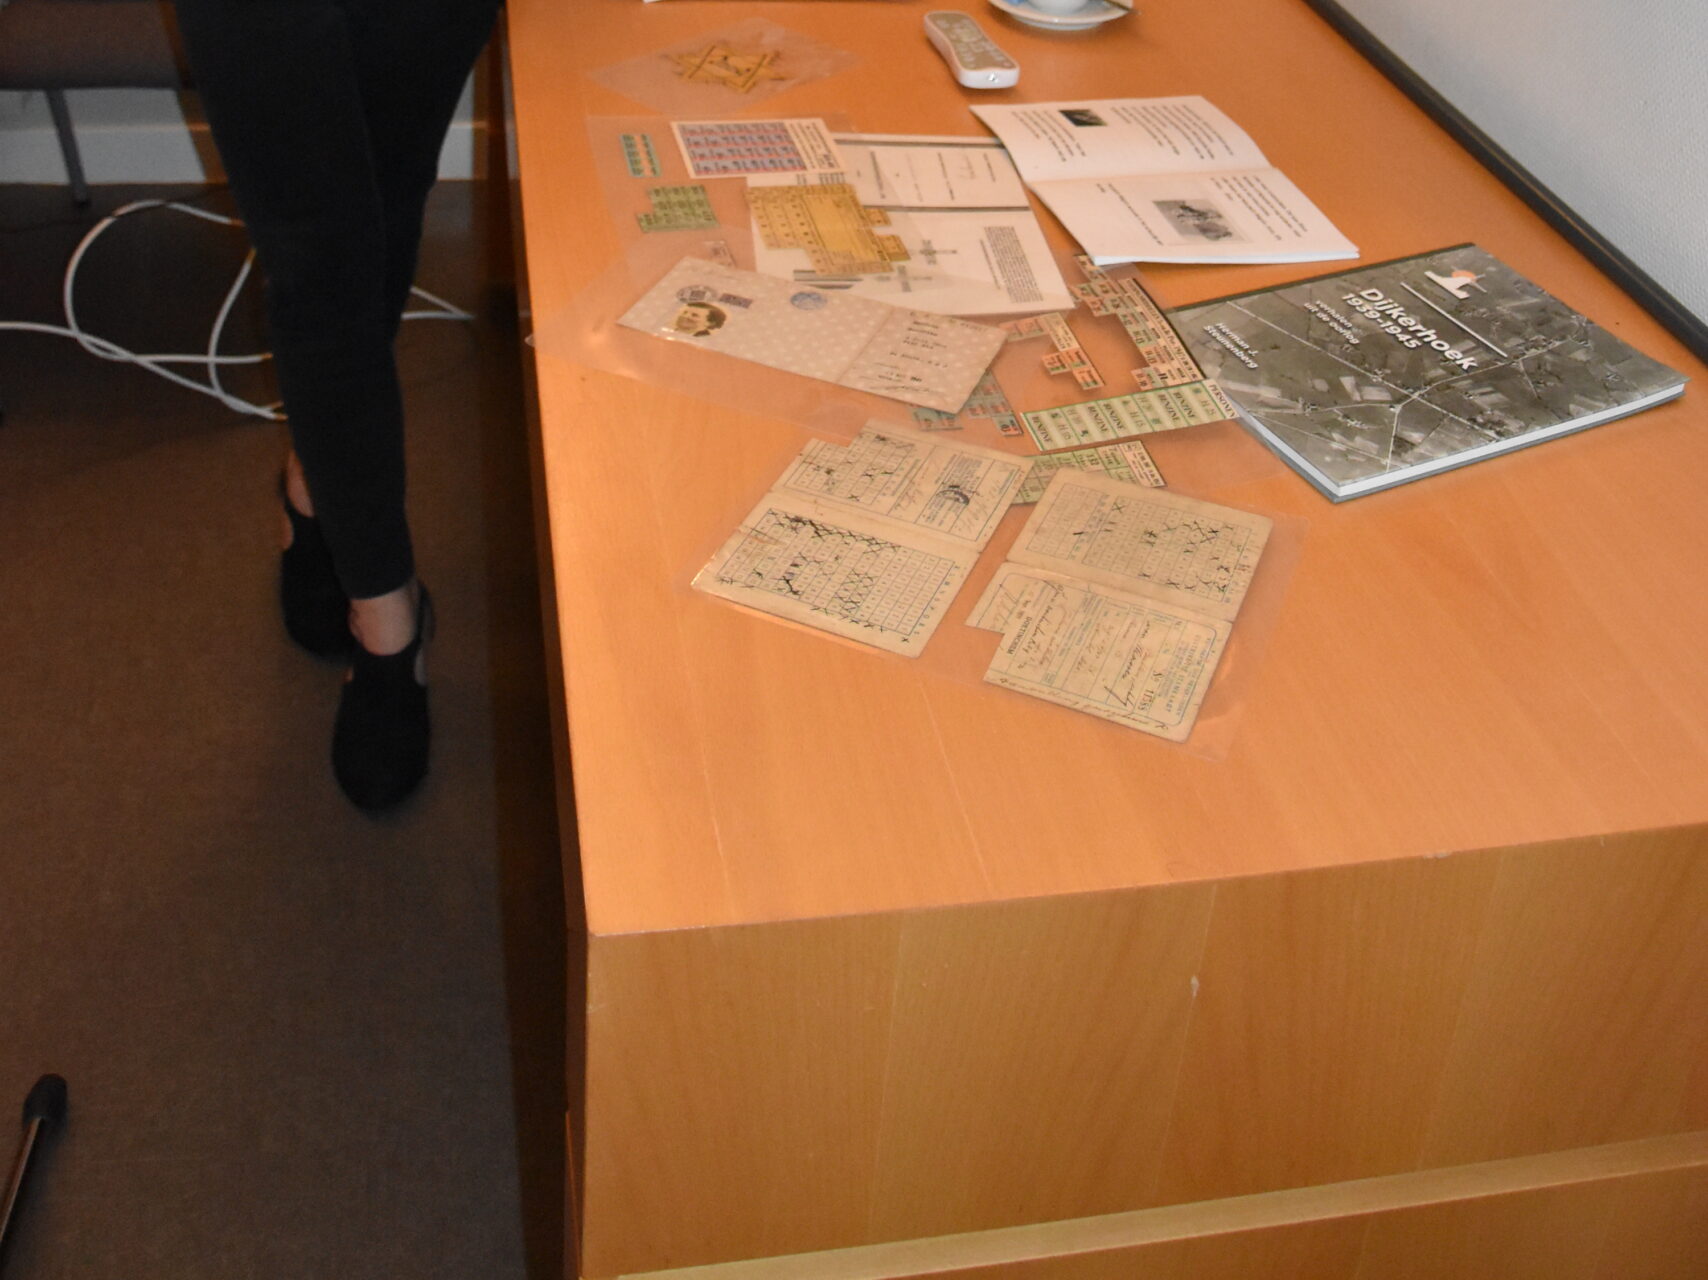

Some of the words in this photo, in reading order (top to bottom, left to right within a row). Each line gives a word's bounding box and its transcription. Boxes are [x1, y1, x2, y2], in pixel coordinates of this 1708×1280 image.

[1303, 302, 1319, 313] uit
[1316, 312, 1330, 322] de
[1329, 321, 1360, 345] oorlog
[1315, 299, 1353, 328] verhalen
[1341, 292, 1422, 349] 1939-1945
[1359, 287, 1479, 371] Dijkerhoek
[1202, 325, 1259, 369] Steunenberg
[1214, 322, 1250, 350] Herman
